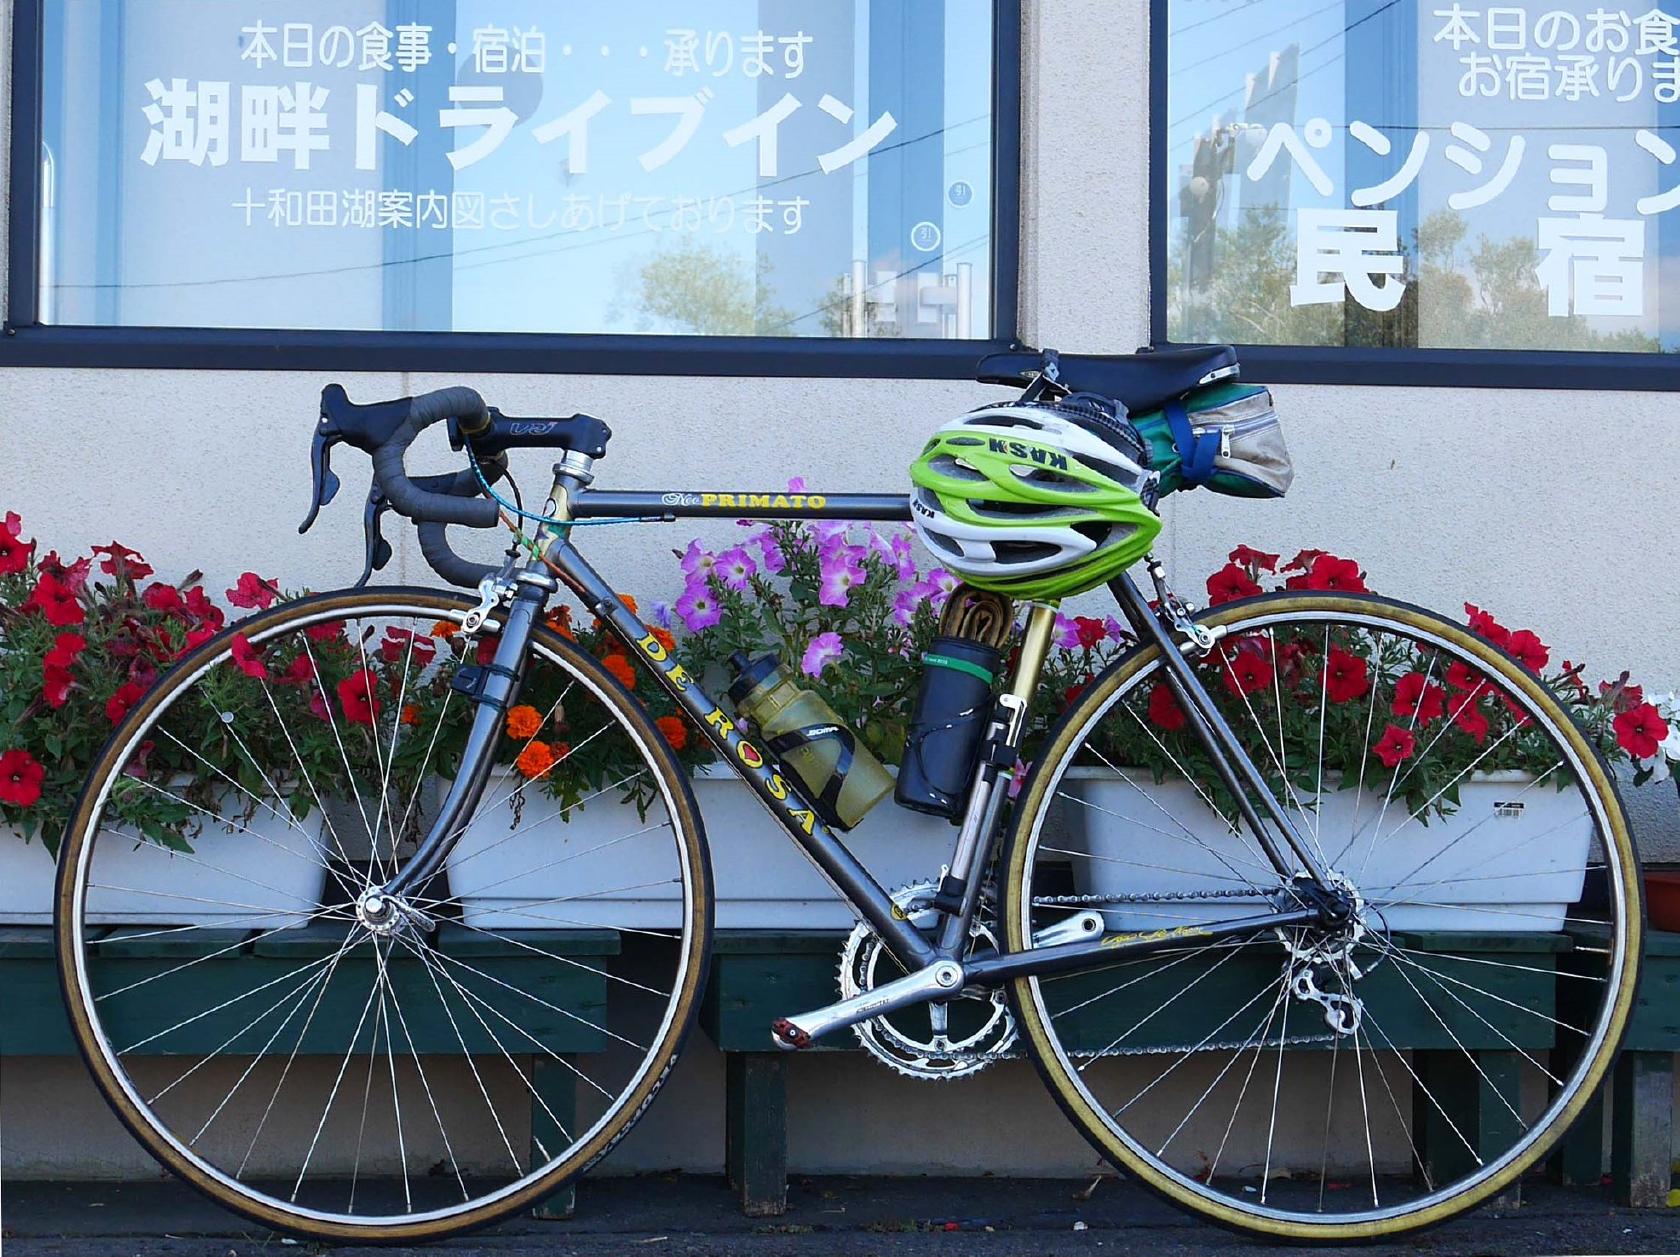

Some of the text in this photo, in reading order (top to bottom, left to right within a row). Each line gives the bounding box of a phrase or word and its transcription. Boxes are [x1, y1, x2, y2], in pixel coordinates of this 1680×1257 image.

[140, 78, 898, 177] 湖畔ドライブイン
[231, 187, 810, 235] 十和田湖案内図さしあげております
[1290, 208, 1646, 317] 民宿
[988, 437, 1068, 471] KASK
[701, 493, 826, 509] PRIMATO
[635, 631, 816, 836] DE ROSA
